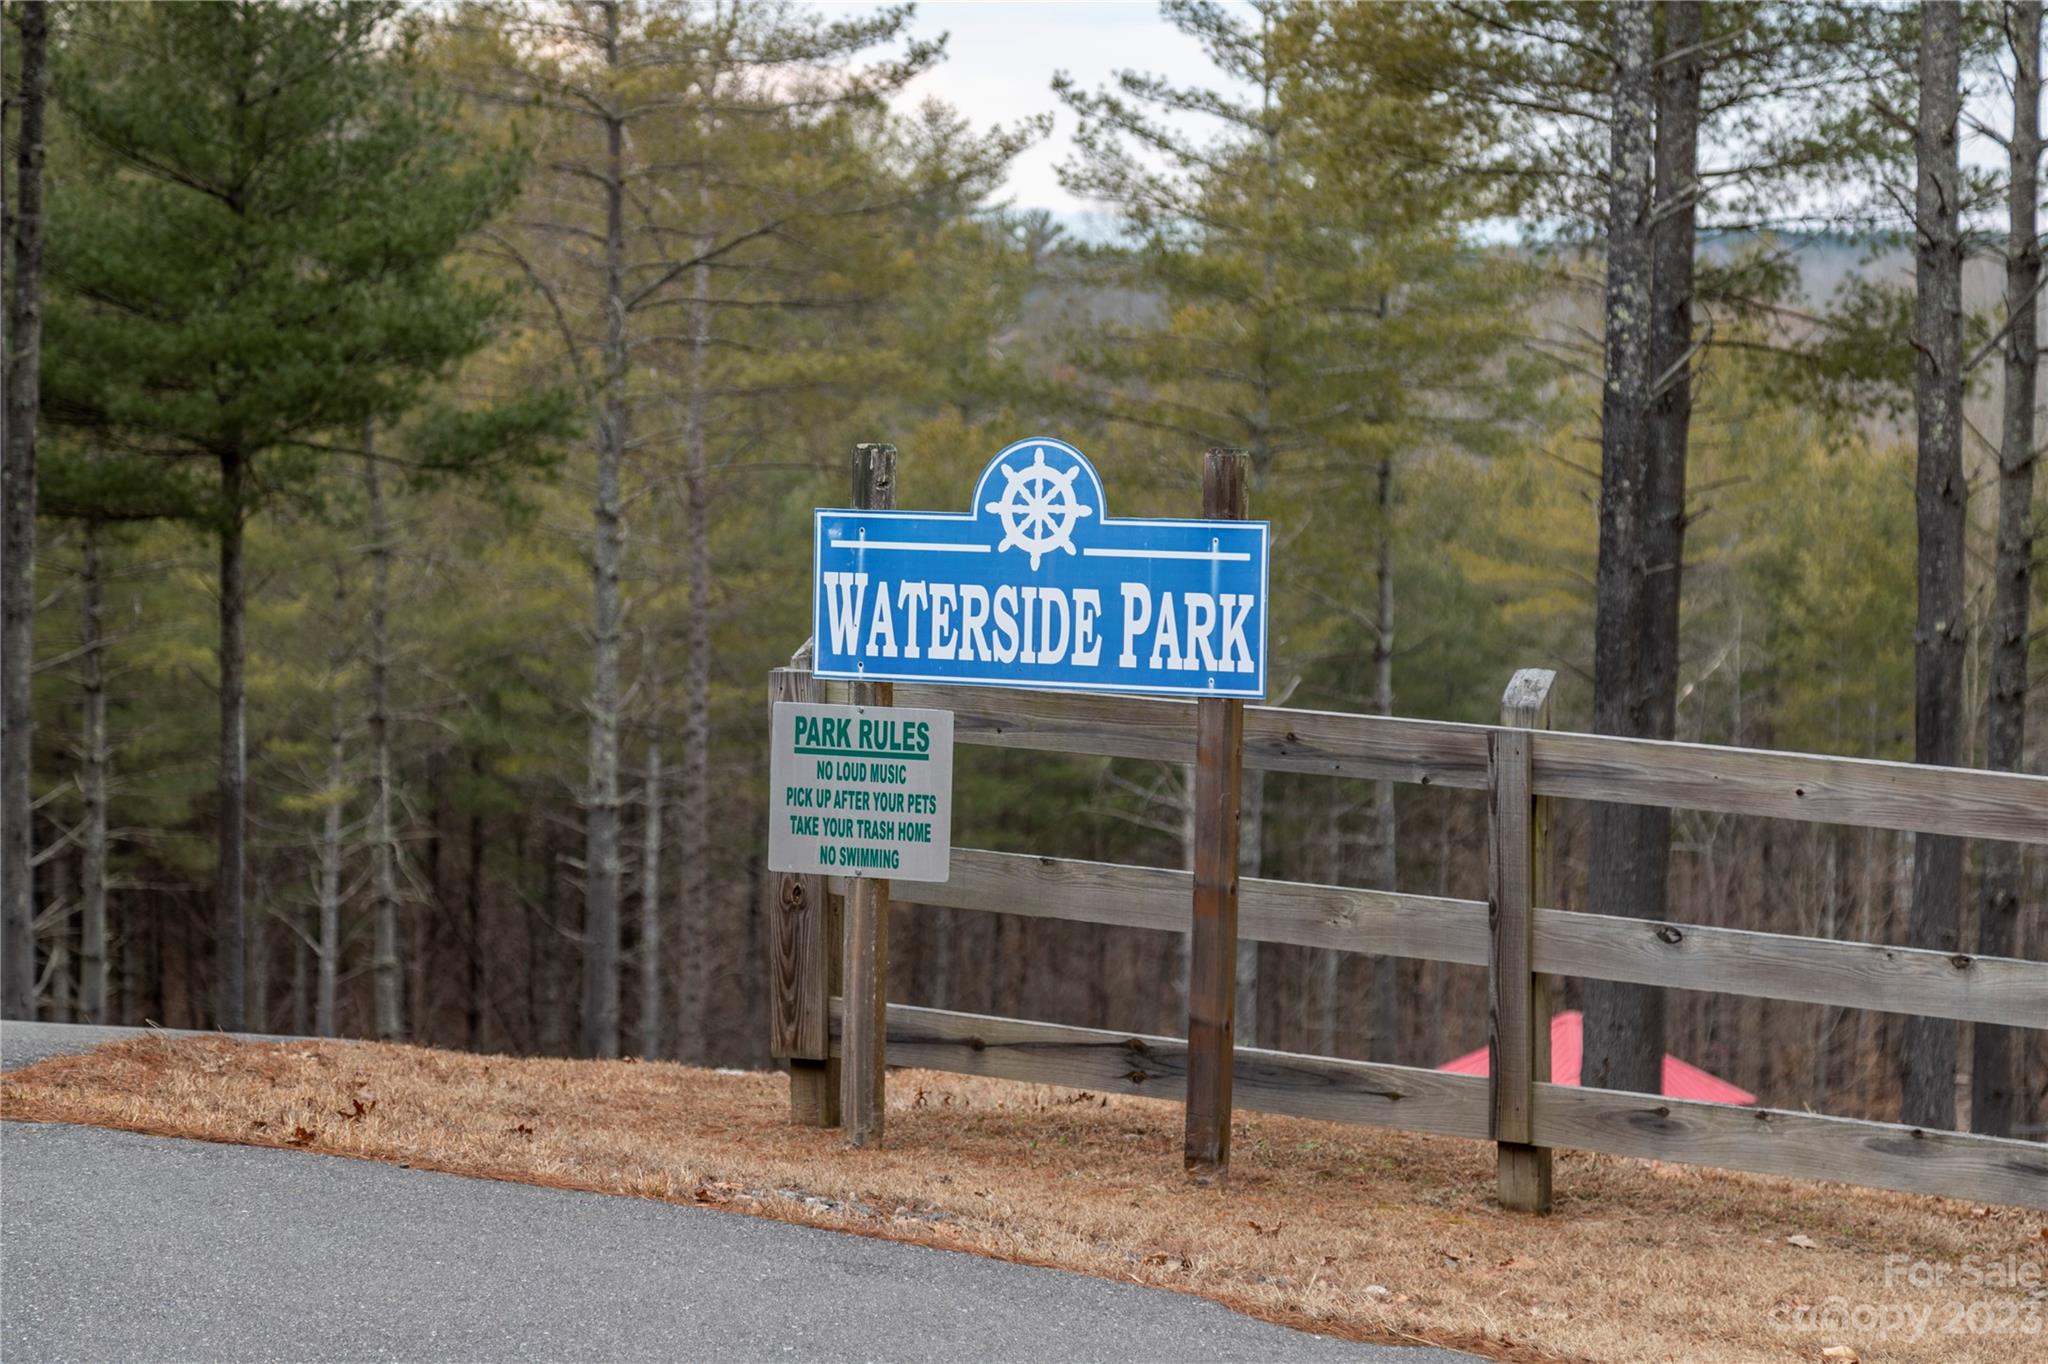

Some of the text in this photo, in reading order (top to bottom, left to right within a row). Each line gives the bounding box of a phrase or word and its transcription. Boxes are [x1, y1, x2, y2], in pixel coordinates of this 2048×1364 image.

[824, 572, 1254, 673] WATERSIDE PARK
[794, 716, 930, 752] PARK RULES
[816, 761, 906, 784] NO LOUD MUSIC
[786, 787, 936, 814] PICK UP AFTER YOUR PETS
[790, 815, 931, 842] TAKE YOUR TRASH HOME
[820, 846, 899, 869] NO SWIMMING
